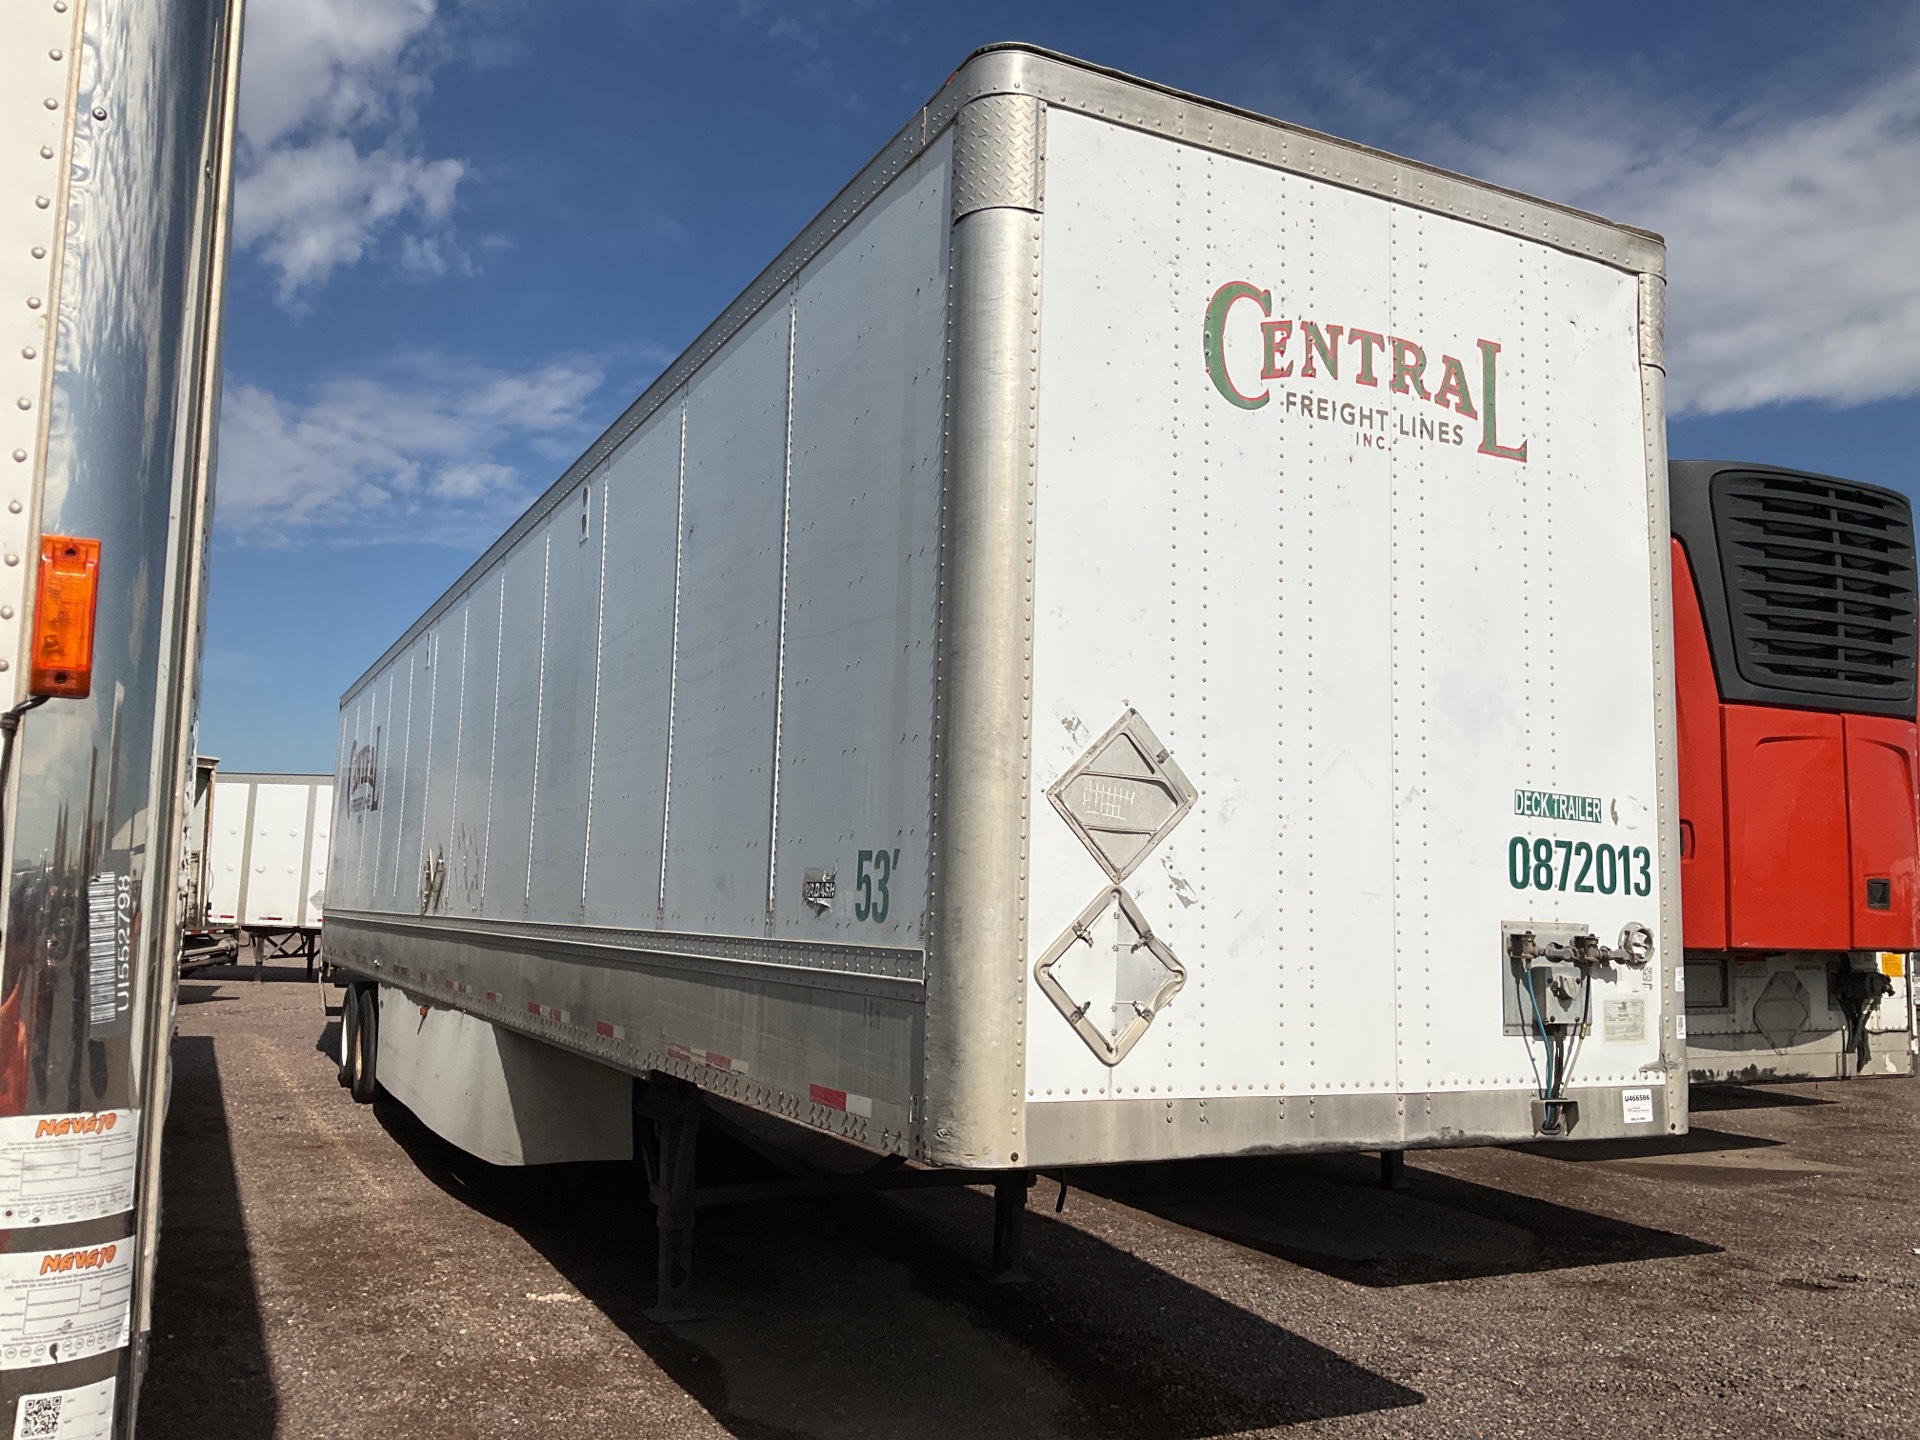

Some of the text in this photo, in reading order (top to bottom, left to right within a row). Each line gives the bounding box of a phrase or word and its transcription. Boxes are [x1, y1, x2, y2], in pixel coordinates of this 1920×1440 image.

[1203, 281, 1528, 463] CENTRAL
[1286, 392, 1464, 446] FREIGHT LINES
[1515, 790, 1602, 823] DECK TRAILER
[1508, 836, 1652, 897] 0872013
[35, 1112, 117, 1139] NAVAJO
[39, 1244, 117, 1276] NAVAJO
